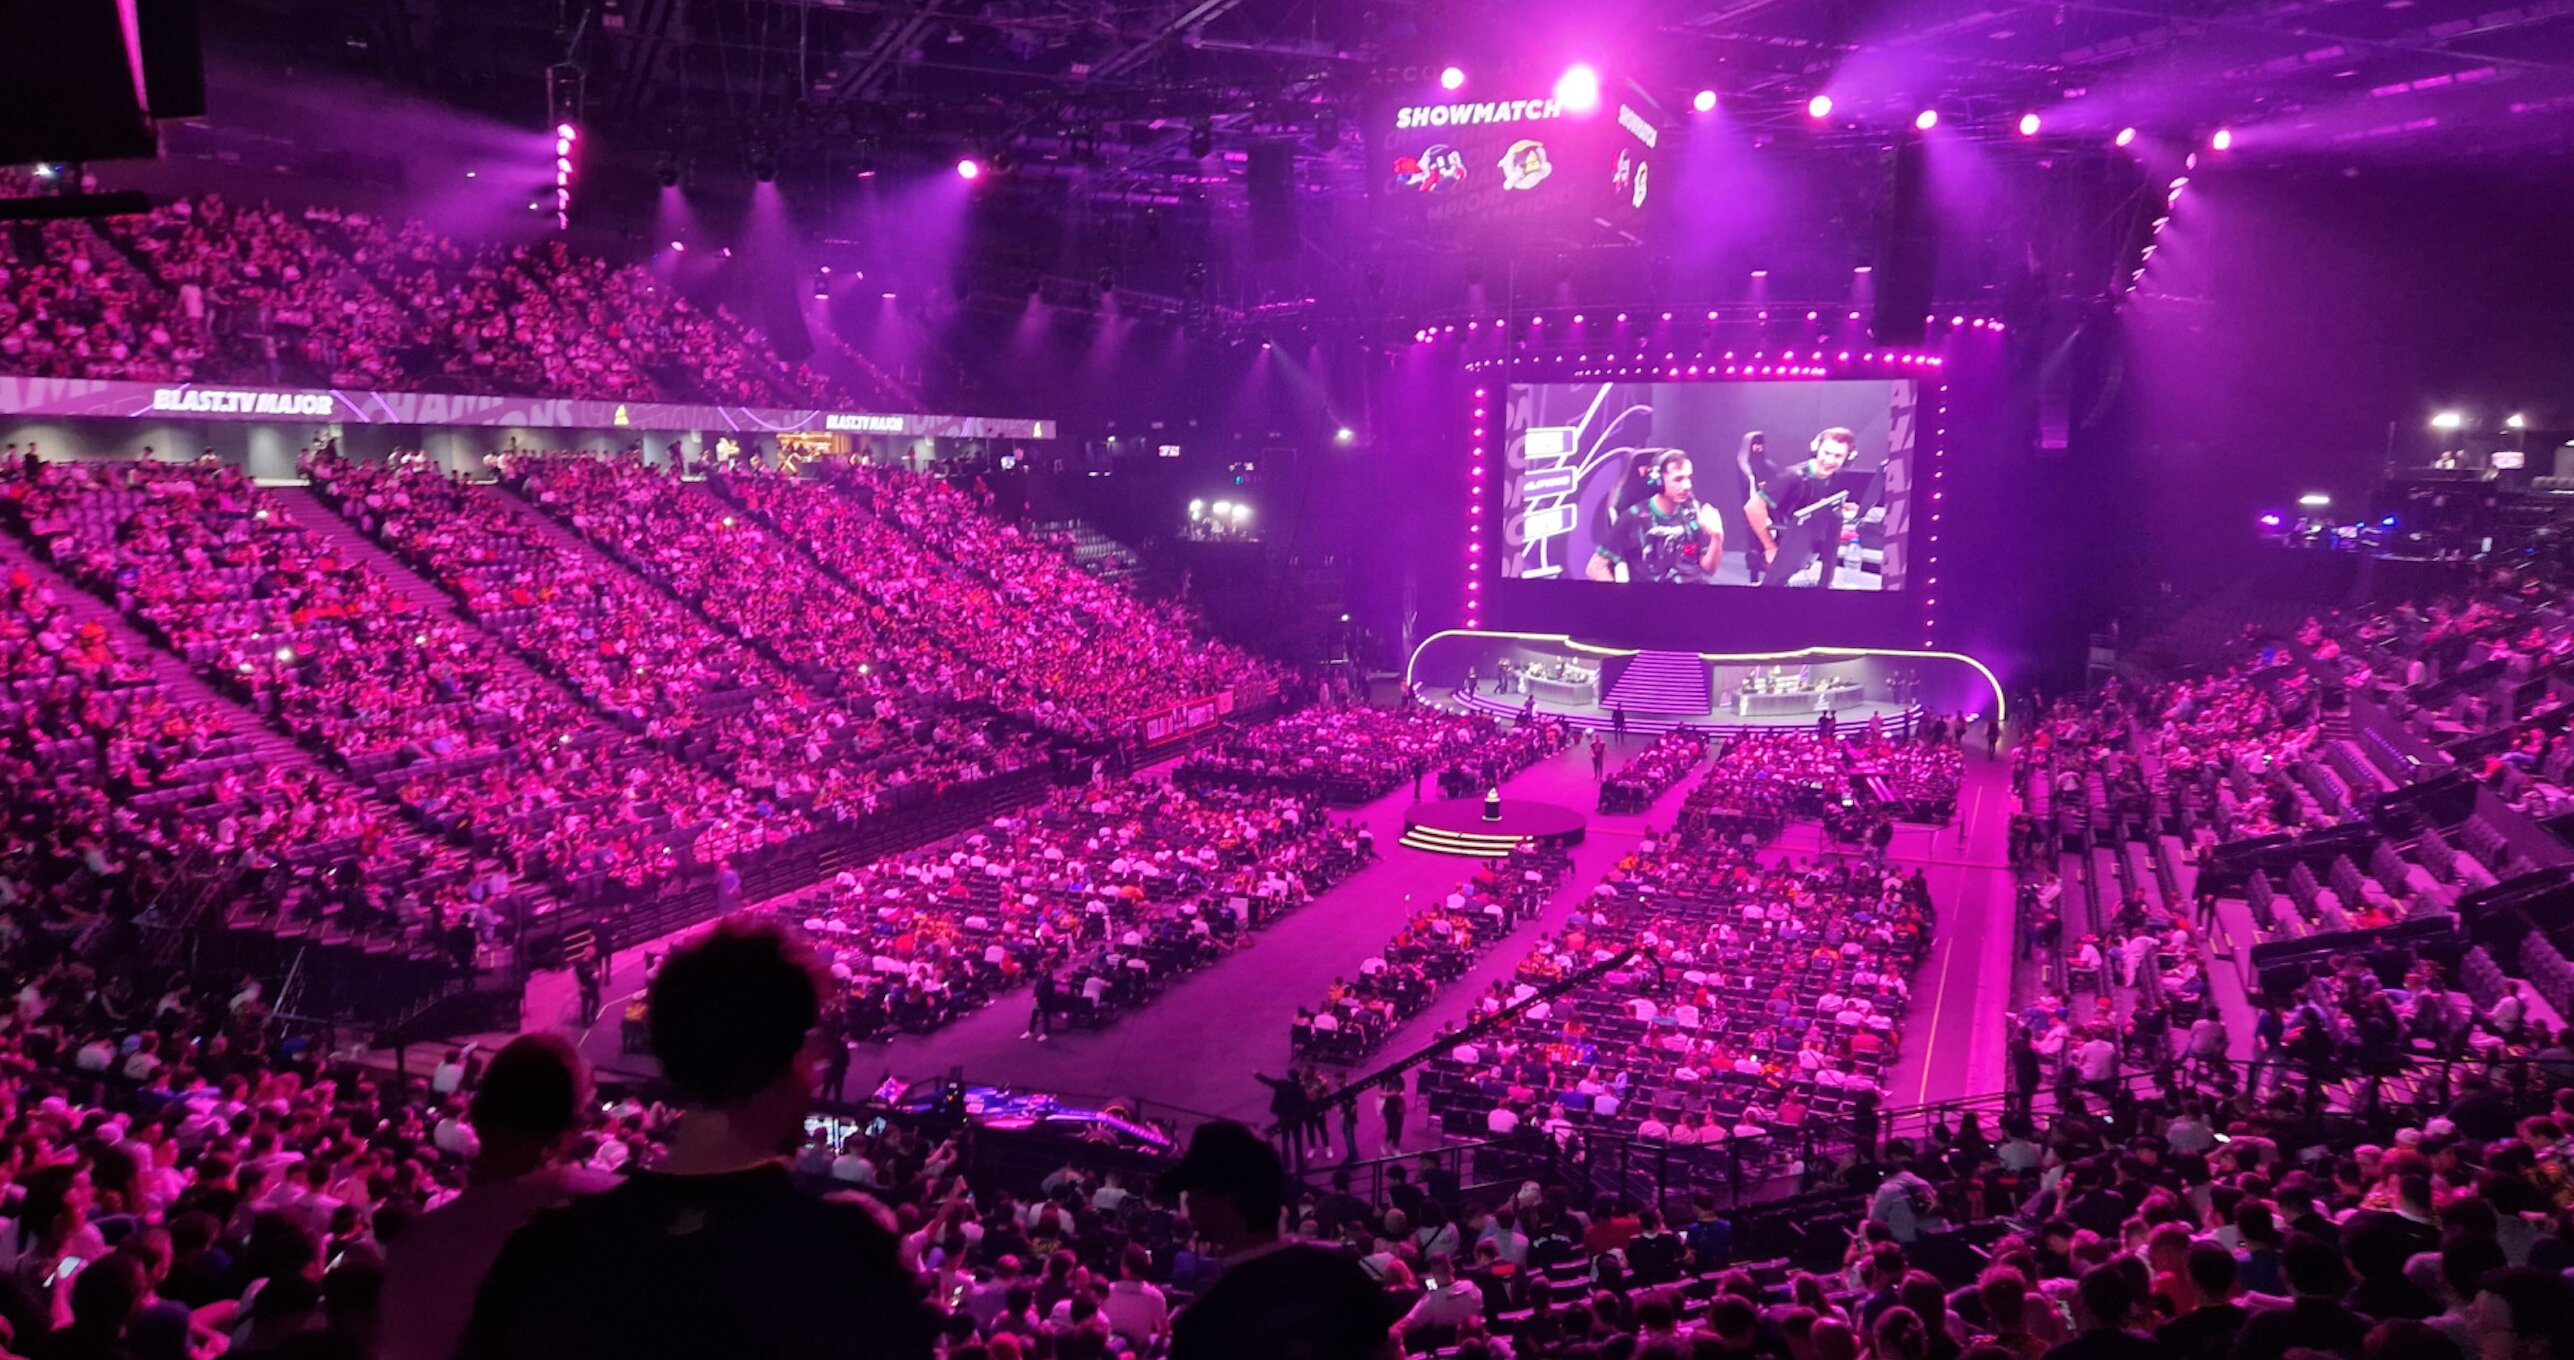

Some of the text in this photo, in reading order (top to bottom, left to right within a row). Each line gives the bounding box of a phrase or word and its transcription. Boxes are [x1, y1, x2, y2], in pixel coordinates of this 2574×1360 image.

[1395, 98, 1562, 128] SHOWMATCH
[153, 389, 333, 415] BLAST.TV MAJOR
